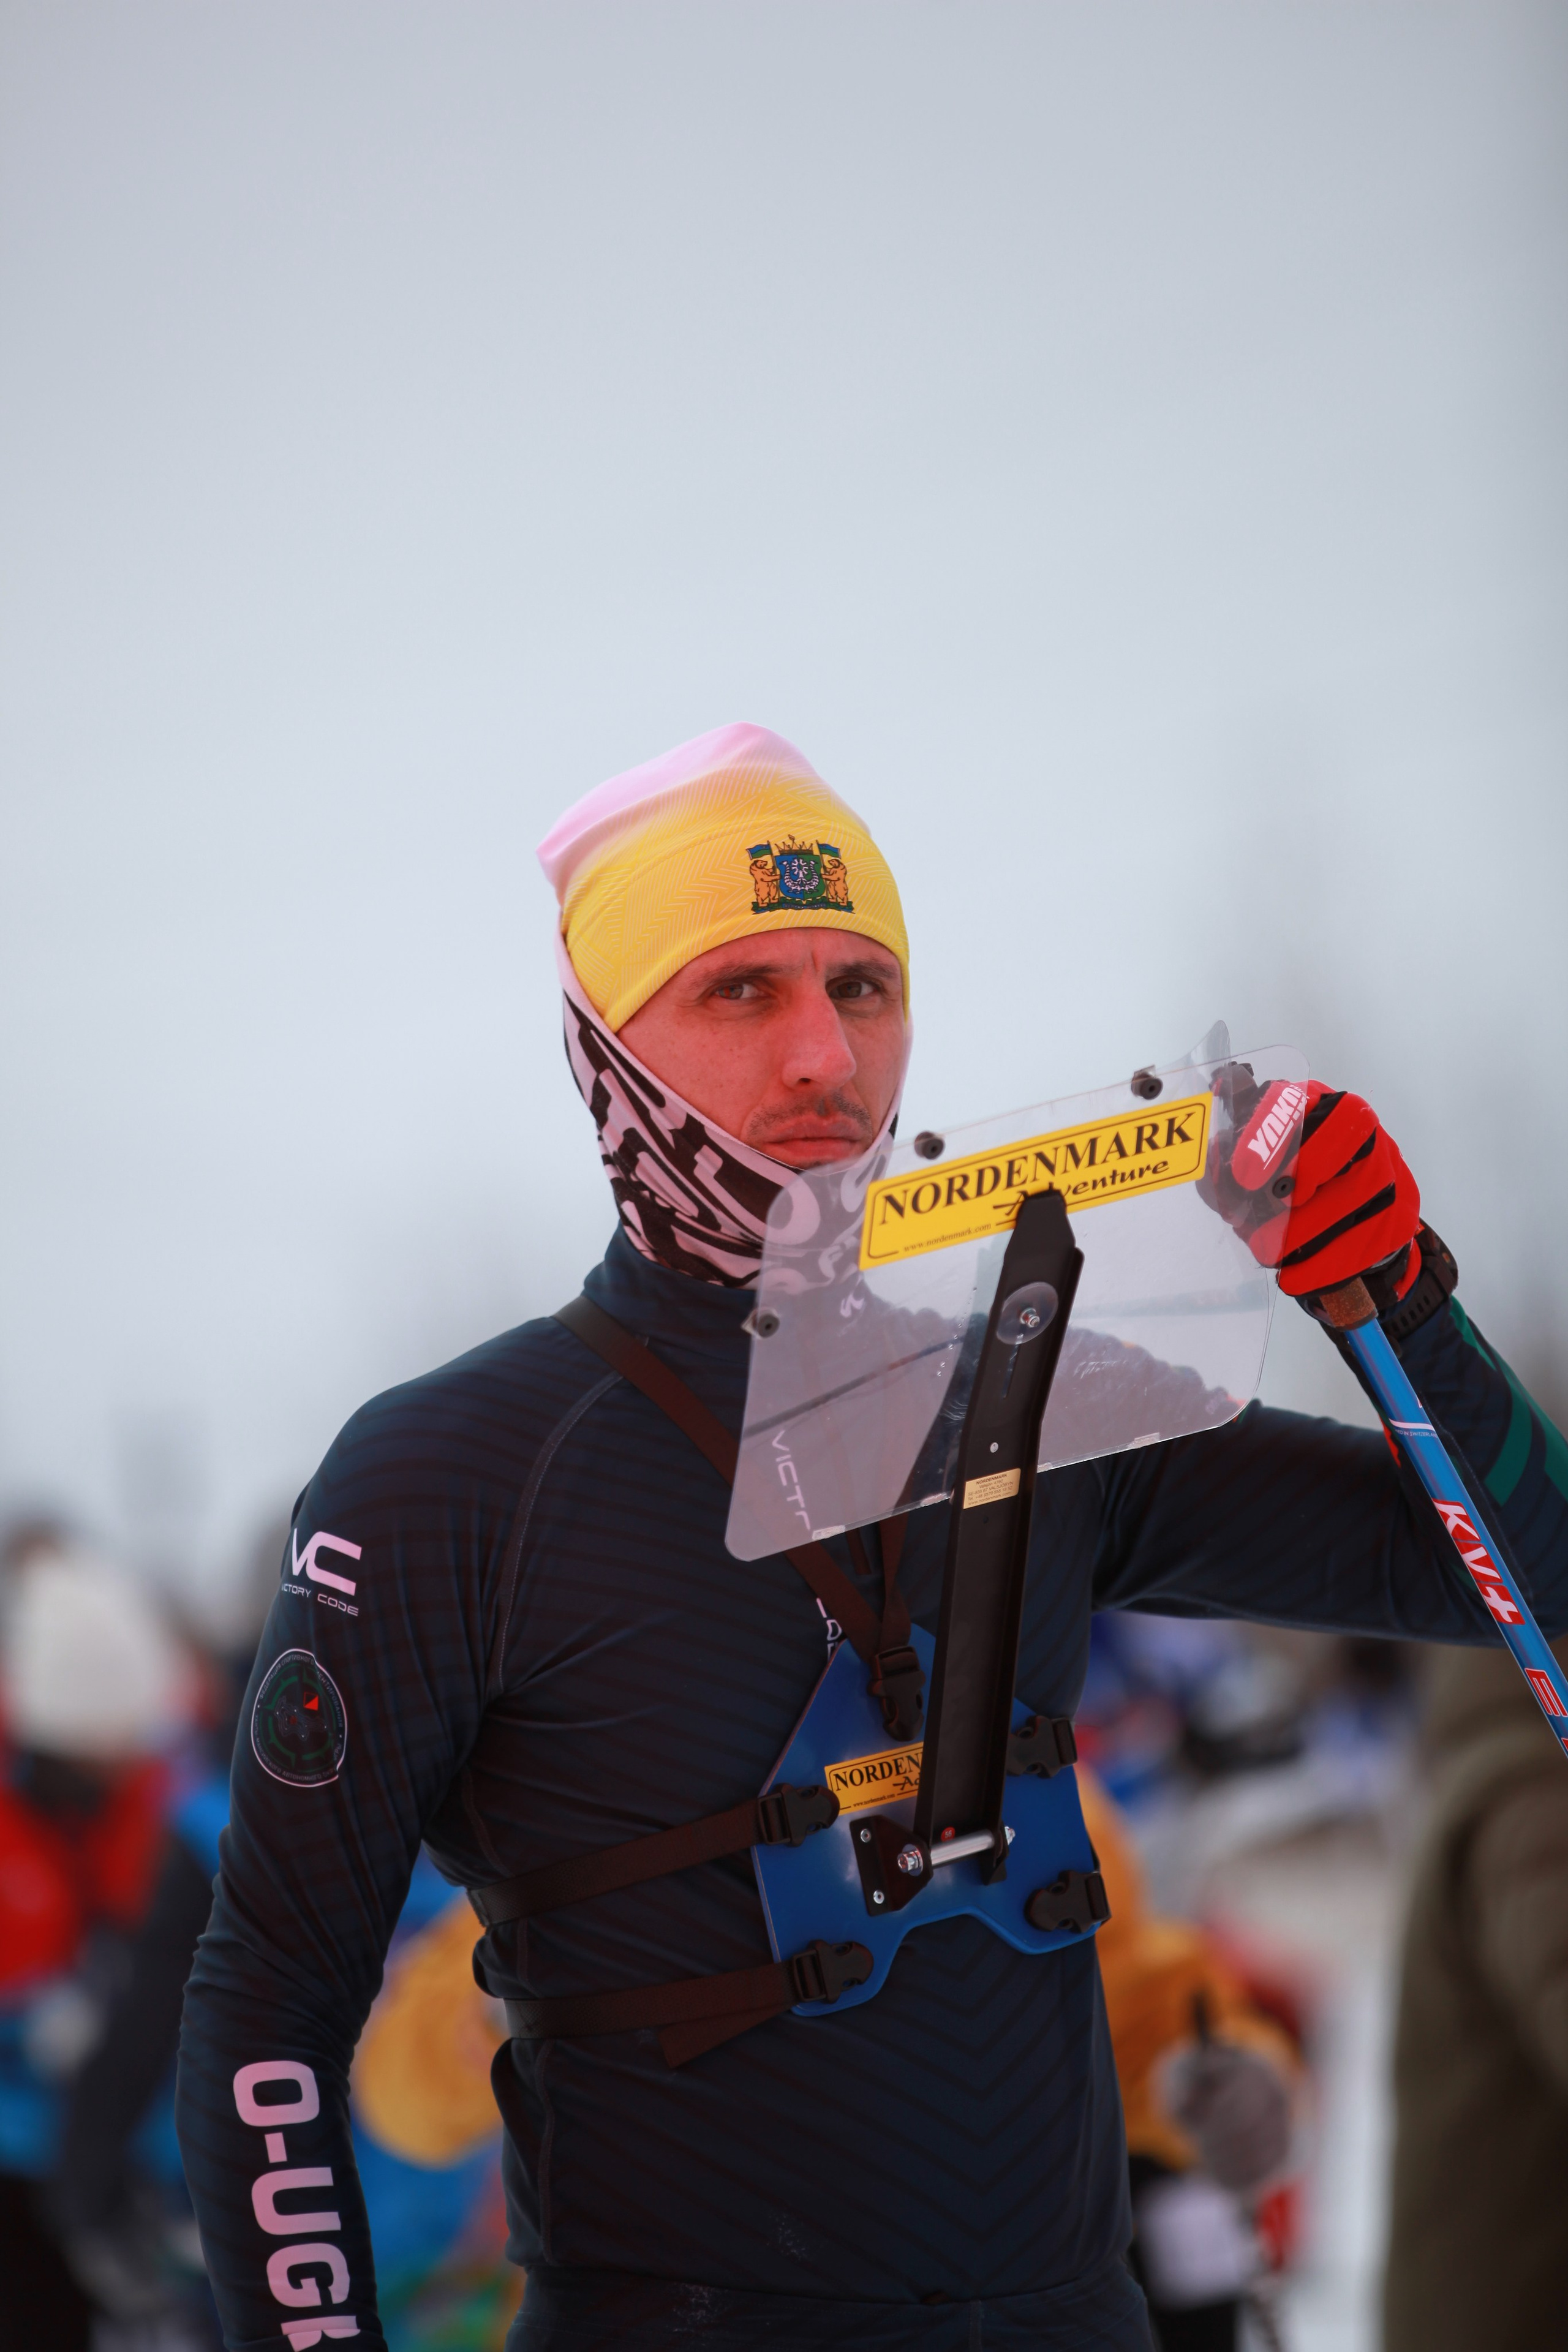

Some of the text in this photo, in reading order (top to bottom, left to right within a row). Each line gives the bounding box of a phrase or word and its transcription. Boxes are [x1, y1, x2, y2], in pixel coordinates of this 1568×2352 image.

[879, 1112, 1196, 1225] NORDENMARK
[993, 1160, 1170, 1216] Aventure
[903, 1223, 992, 1252] www.nordenmark.com
[976, 1474, 1008, 1485] NORDENMARK
[292, 1527, 363, 1597] VC
[281, 1583, 360, 1617] ICTORY CODE
[832, 1751, 924, 1792] NORDEN
